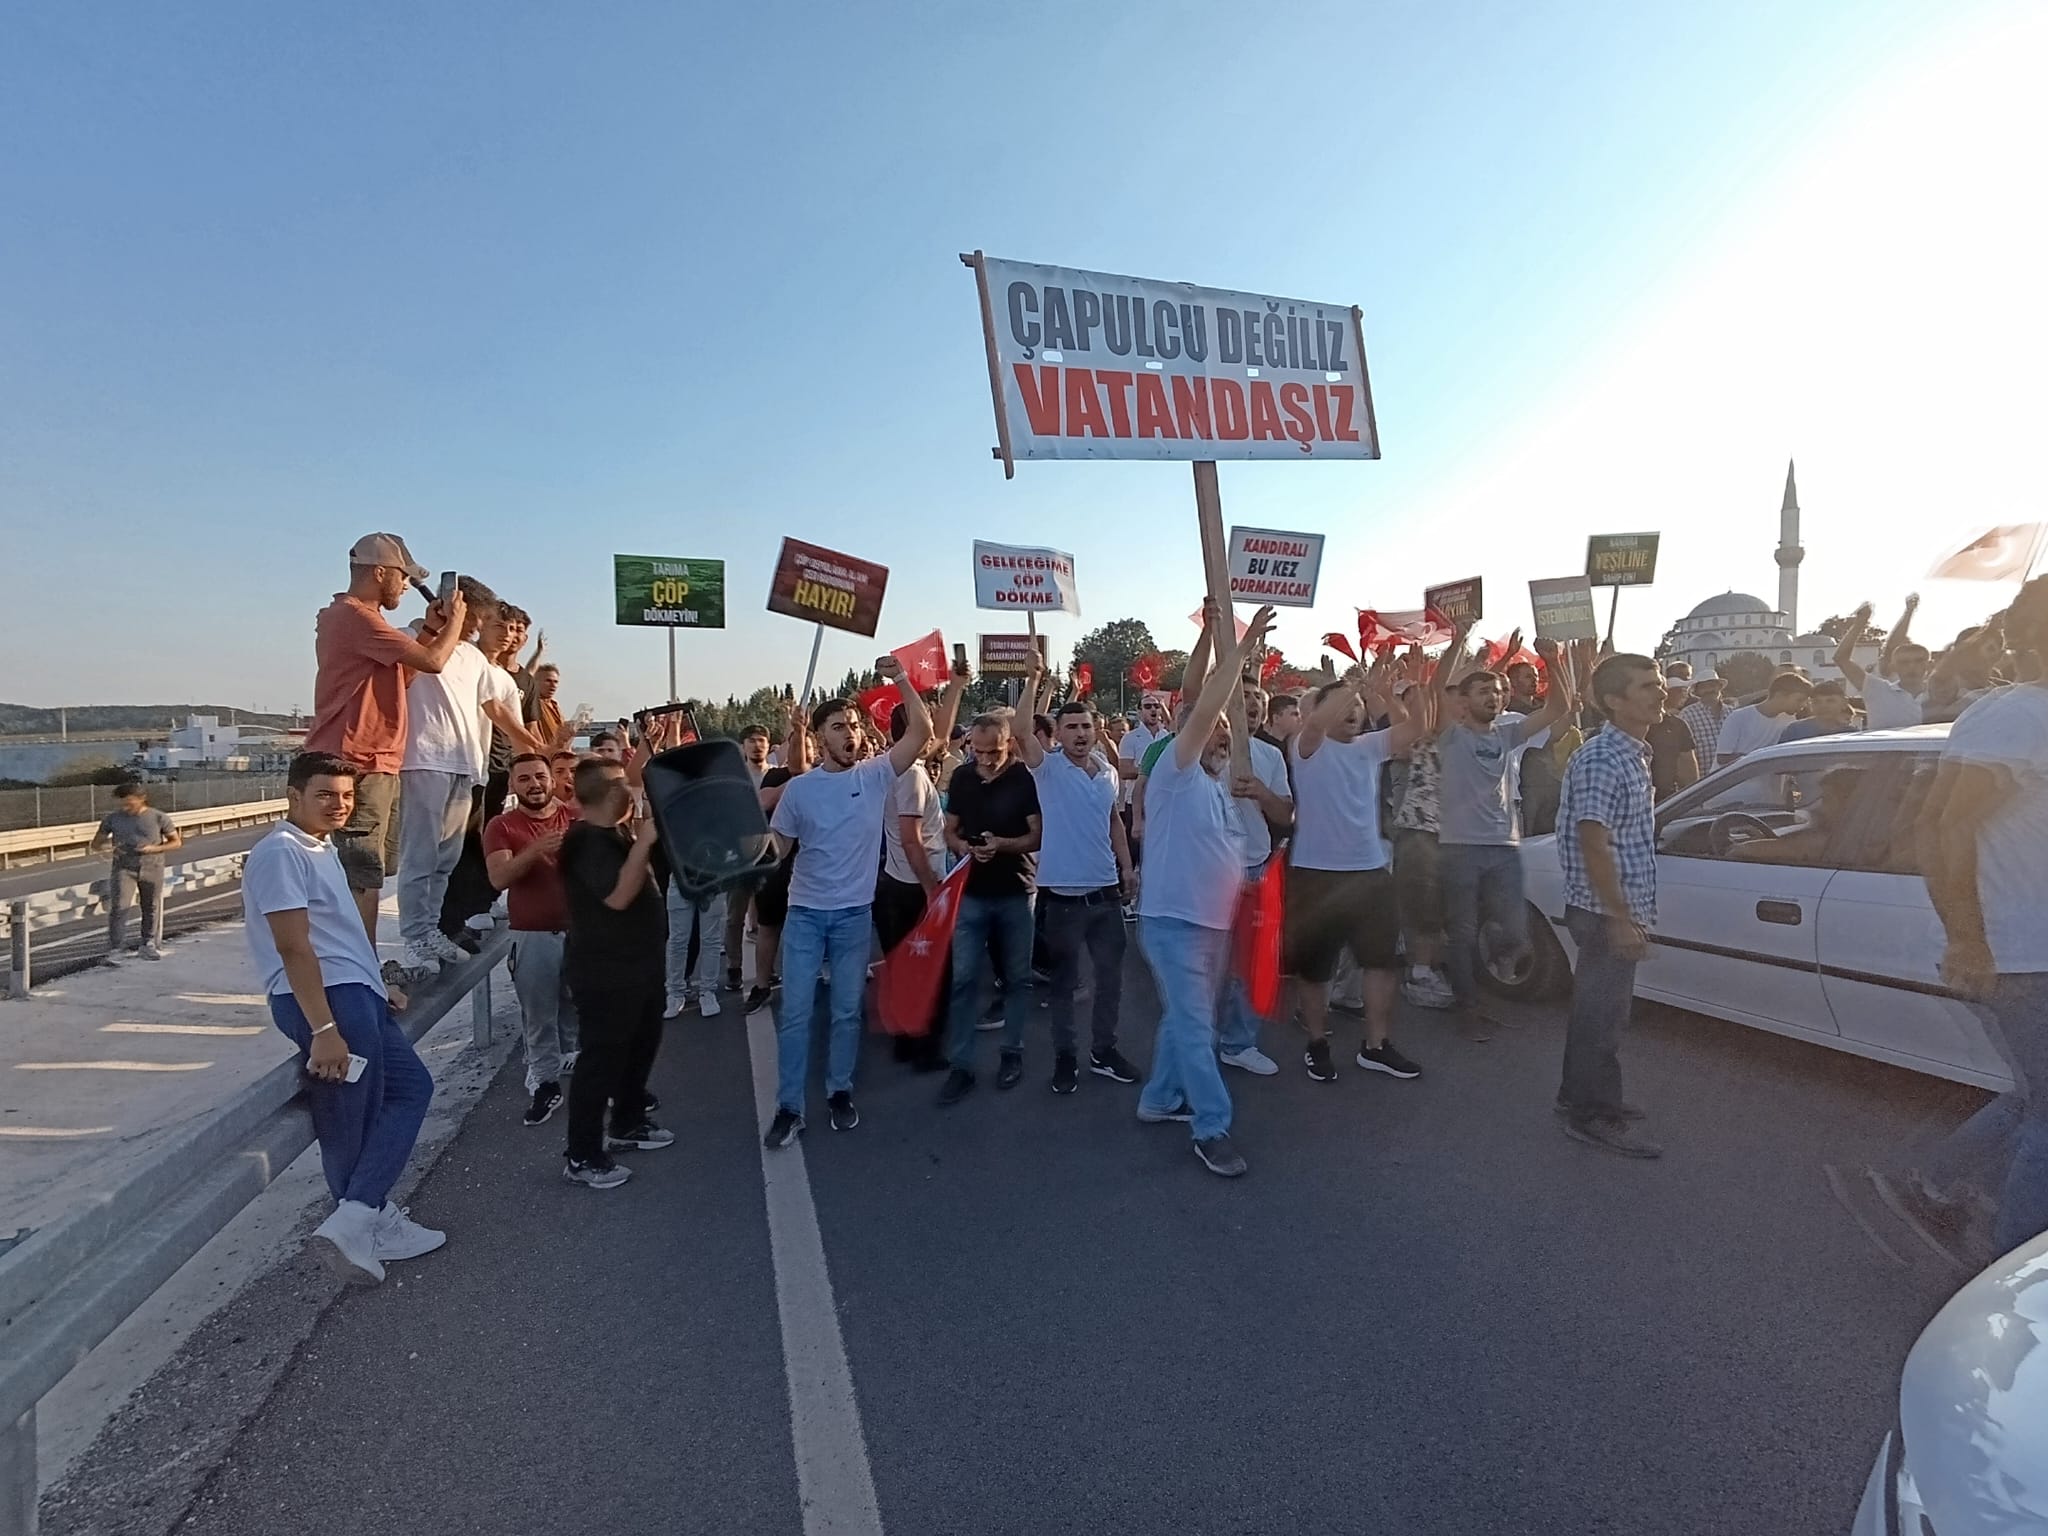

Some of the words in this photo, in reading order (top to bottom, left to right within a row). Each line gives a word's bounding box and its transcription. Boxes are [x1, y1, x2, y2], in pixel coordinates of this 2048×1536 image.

[1007, 281, 1209, 364] ÇAPULCU
[1216, 301, 1348, 371] DEĞİLİZ
[1012, 363, 1361, 453] VATANDAŞIZ
[1243, 538, 1309, 557] KANDIRALI
[652, 562, 689, 577] TARIMA
[981, 554, 1070, 577] GELECEĞİME
[1247, 558, 1269, 575] BU
[1271, 559, 1300, 577] KEZ
[1013, 571, 1044, 590] ÇÖP
[1230, 577, 1312, 597] DURMAYACAK
[653, 577, 689, 607] ÇÖP
[793, 579, 857, 619] HAYIR!
[995, 588, 1054, 604] DÖKME
[643, 606, 699, 623] DÖKMEYİN!
